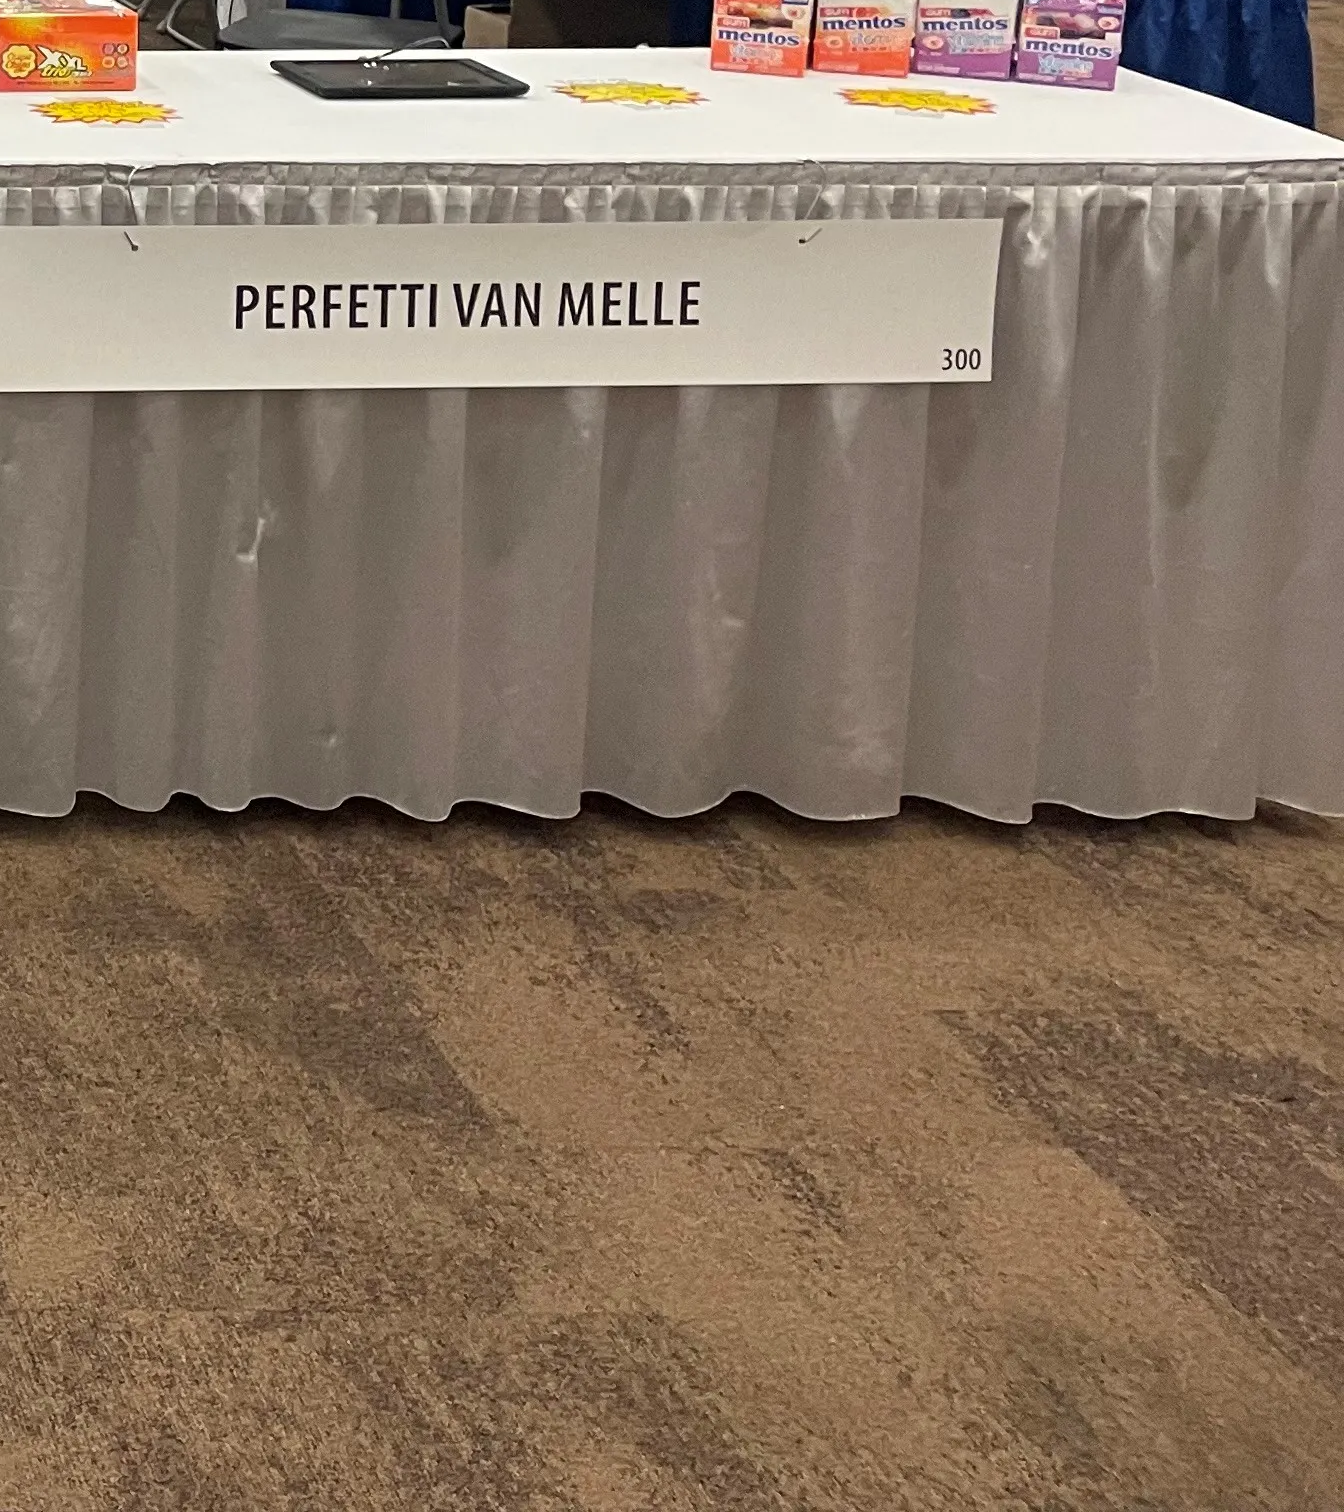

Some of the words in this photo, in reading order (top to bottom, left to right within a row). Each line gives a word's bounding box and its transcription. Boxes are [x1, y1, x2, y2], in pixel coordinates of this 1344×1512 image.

[822, 16, 907, 31] mentos
[922, 18, 1009, 32] mentos
[717, 29, 801, 47] mentos
[1025, 39, 1113, 59] mentos
[235, 283, 438, 330] PERFETTI
[452, 282, 542, 328] VAN
[557, 281, 701, 327] MELLE
[941, 348, 981, 371] 300
